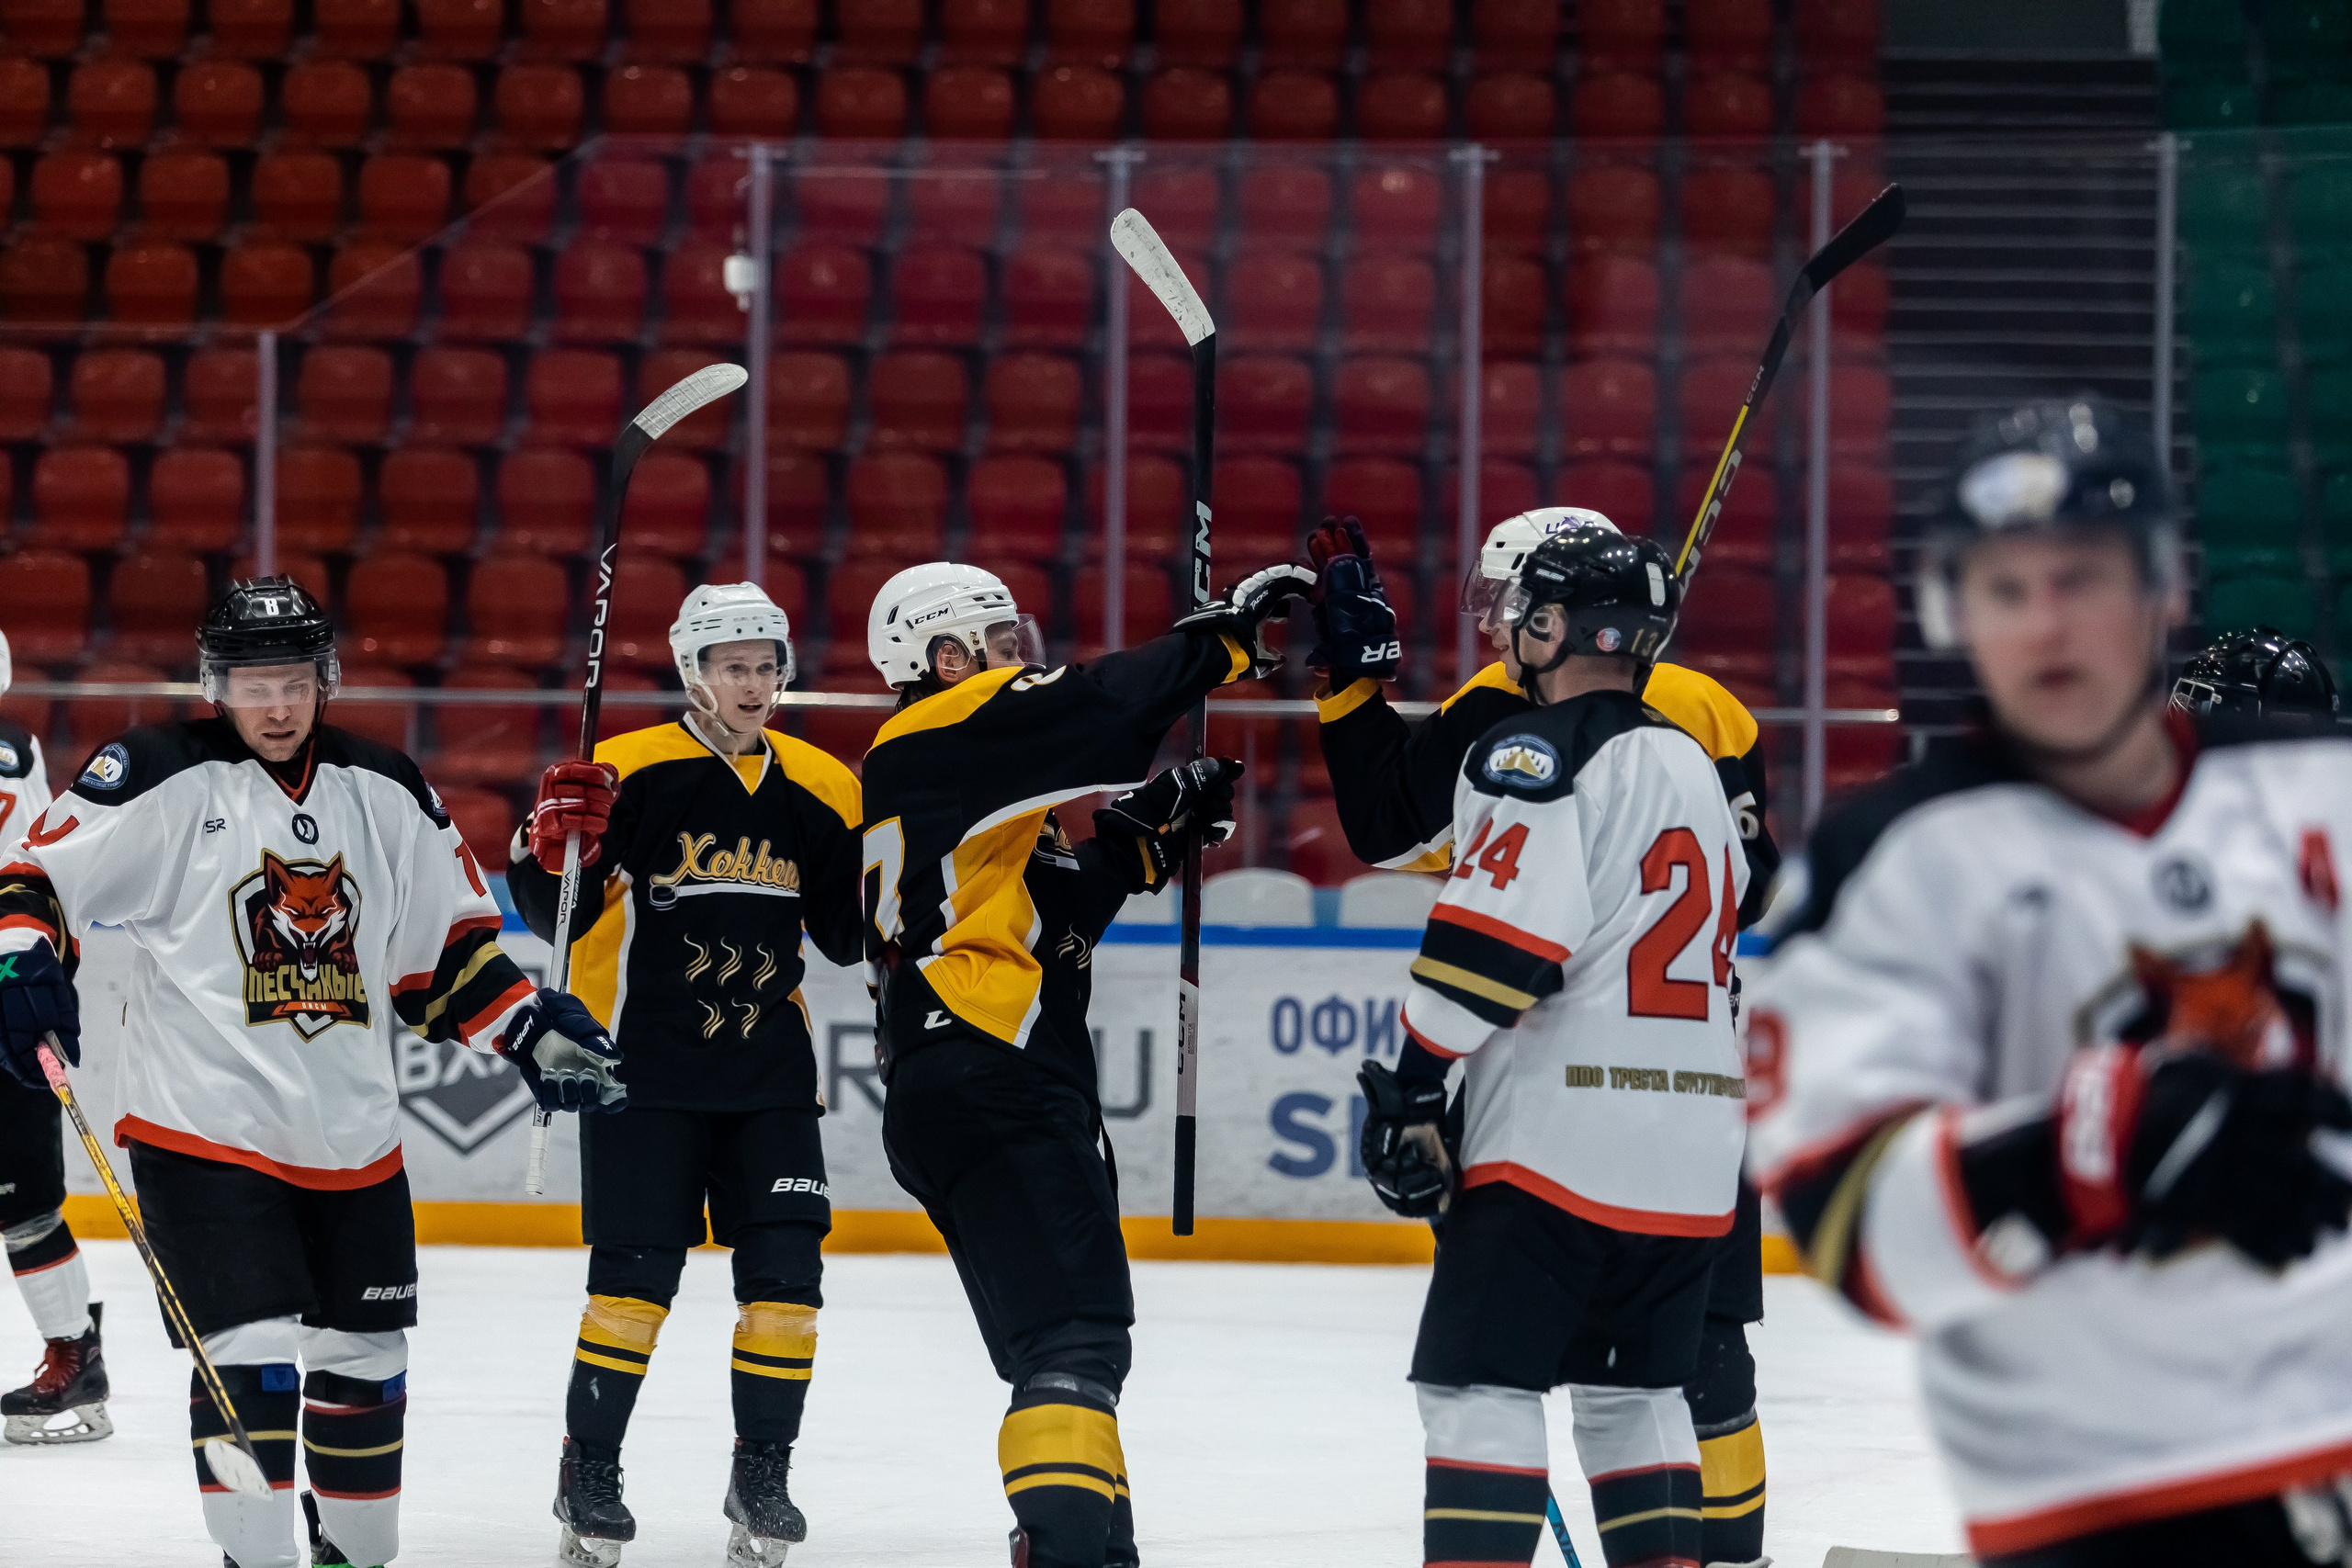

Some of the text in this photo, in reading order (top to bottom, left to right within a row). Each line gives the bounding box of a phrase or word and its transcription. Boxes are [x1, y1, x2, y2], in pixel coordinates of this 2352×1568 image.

[1747, 366, 1764, 404] CCM
[265, 598, 280, 616] 8
[584, 542, 617, 688] VAPOR
[914, 607, 949, 626] CCM
[1729, 791, 1759, 840] 6
[556, 868, 573, 929] VAPOR
[1627, 826, 1739, 1022] 24
[597, 1036, 613, 1051] STX
[1566, 1066, 1605, 1088] ППО
[1609, 1066, 1669, 1092] ТРЕСТА
